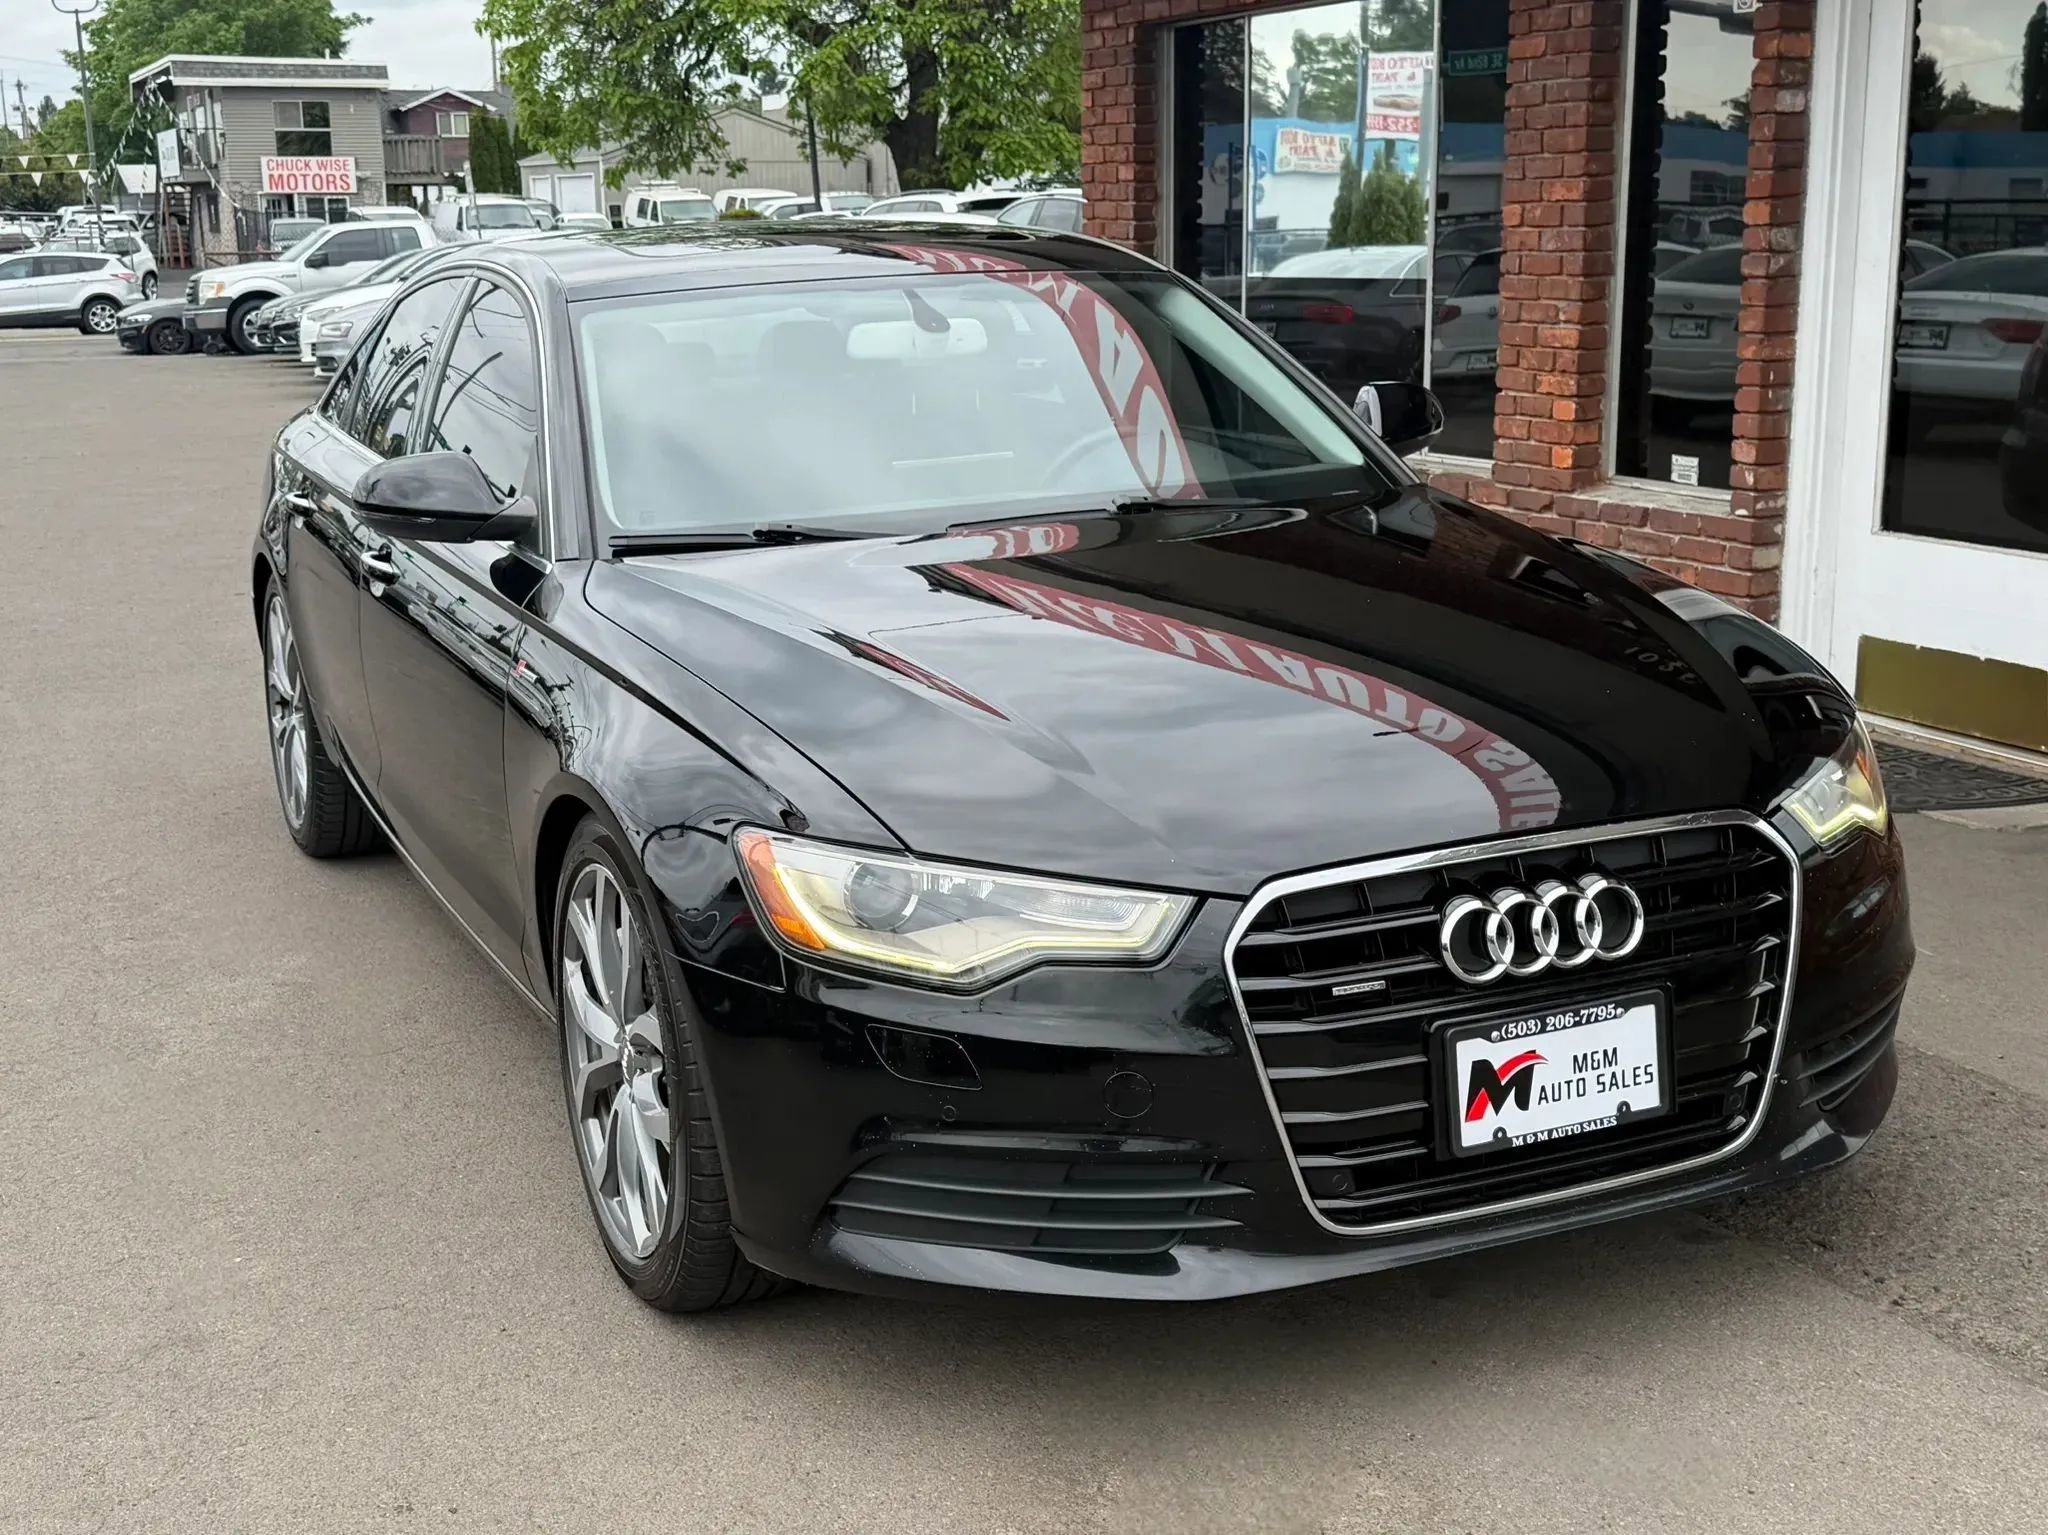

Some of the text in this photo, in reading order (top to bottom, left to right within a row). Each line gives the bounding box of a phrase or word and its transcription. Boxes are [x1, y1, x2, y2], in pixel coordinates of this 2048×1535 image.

[266, 158, 350, 172] CHUCK WISE
[268, 173, 351, 191] MOTORS
[1501, 1003, 1616, 1039] (503) 206-7795
[1572, 1046, 1618, 1075] M&M
[1537, 1063, 1654, 1106] AUTO SALES
[1511, 1136, 1524, 1147] M
[1537, 1131, 1549, 1143] M
[1550, 1125, 1581, 1140] AUTO
[1583, 1116, 1618, 1132] SALES
